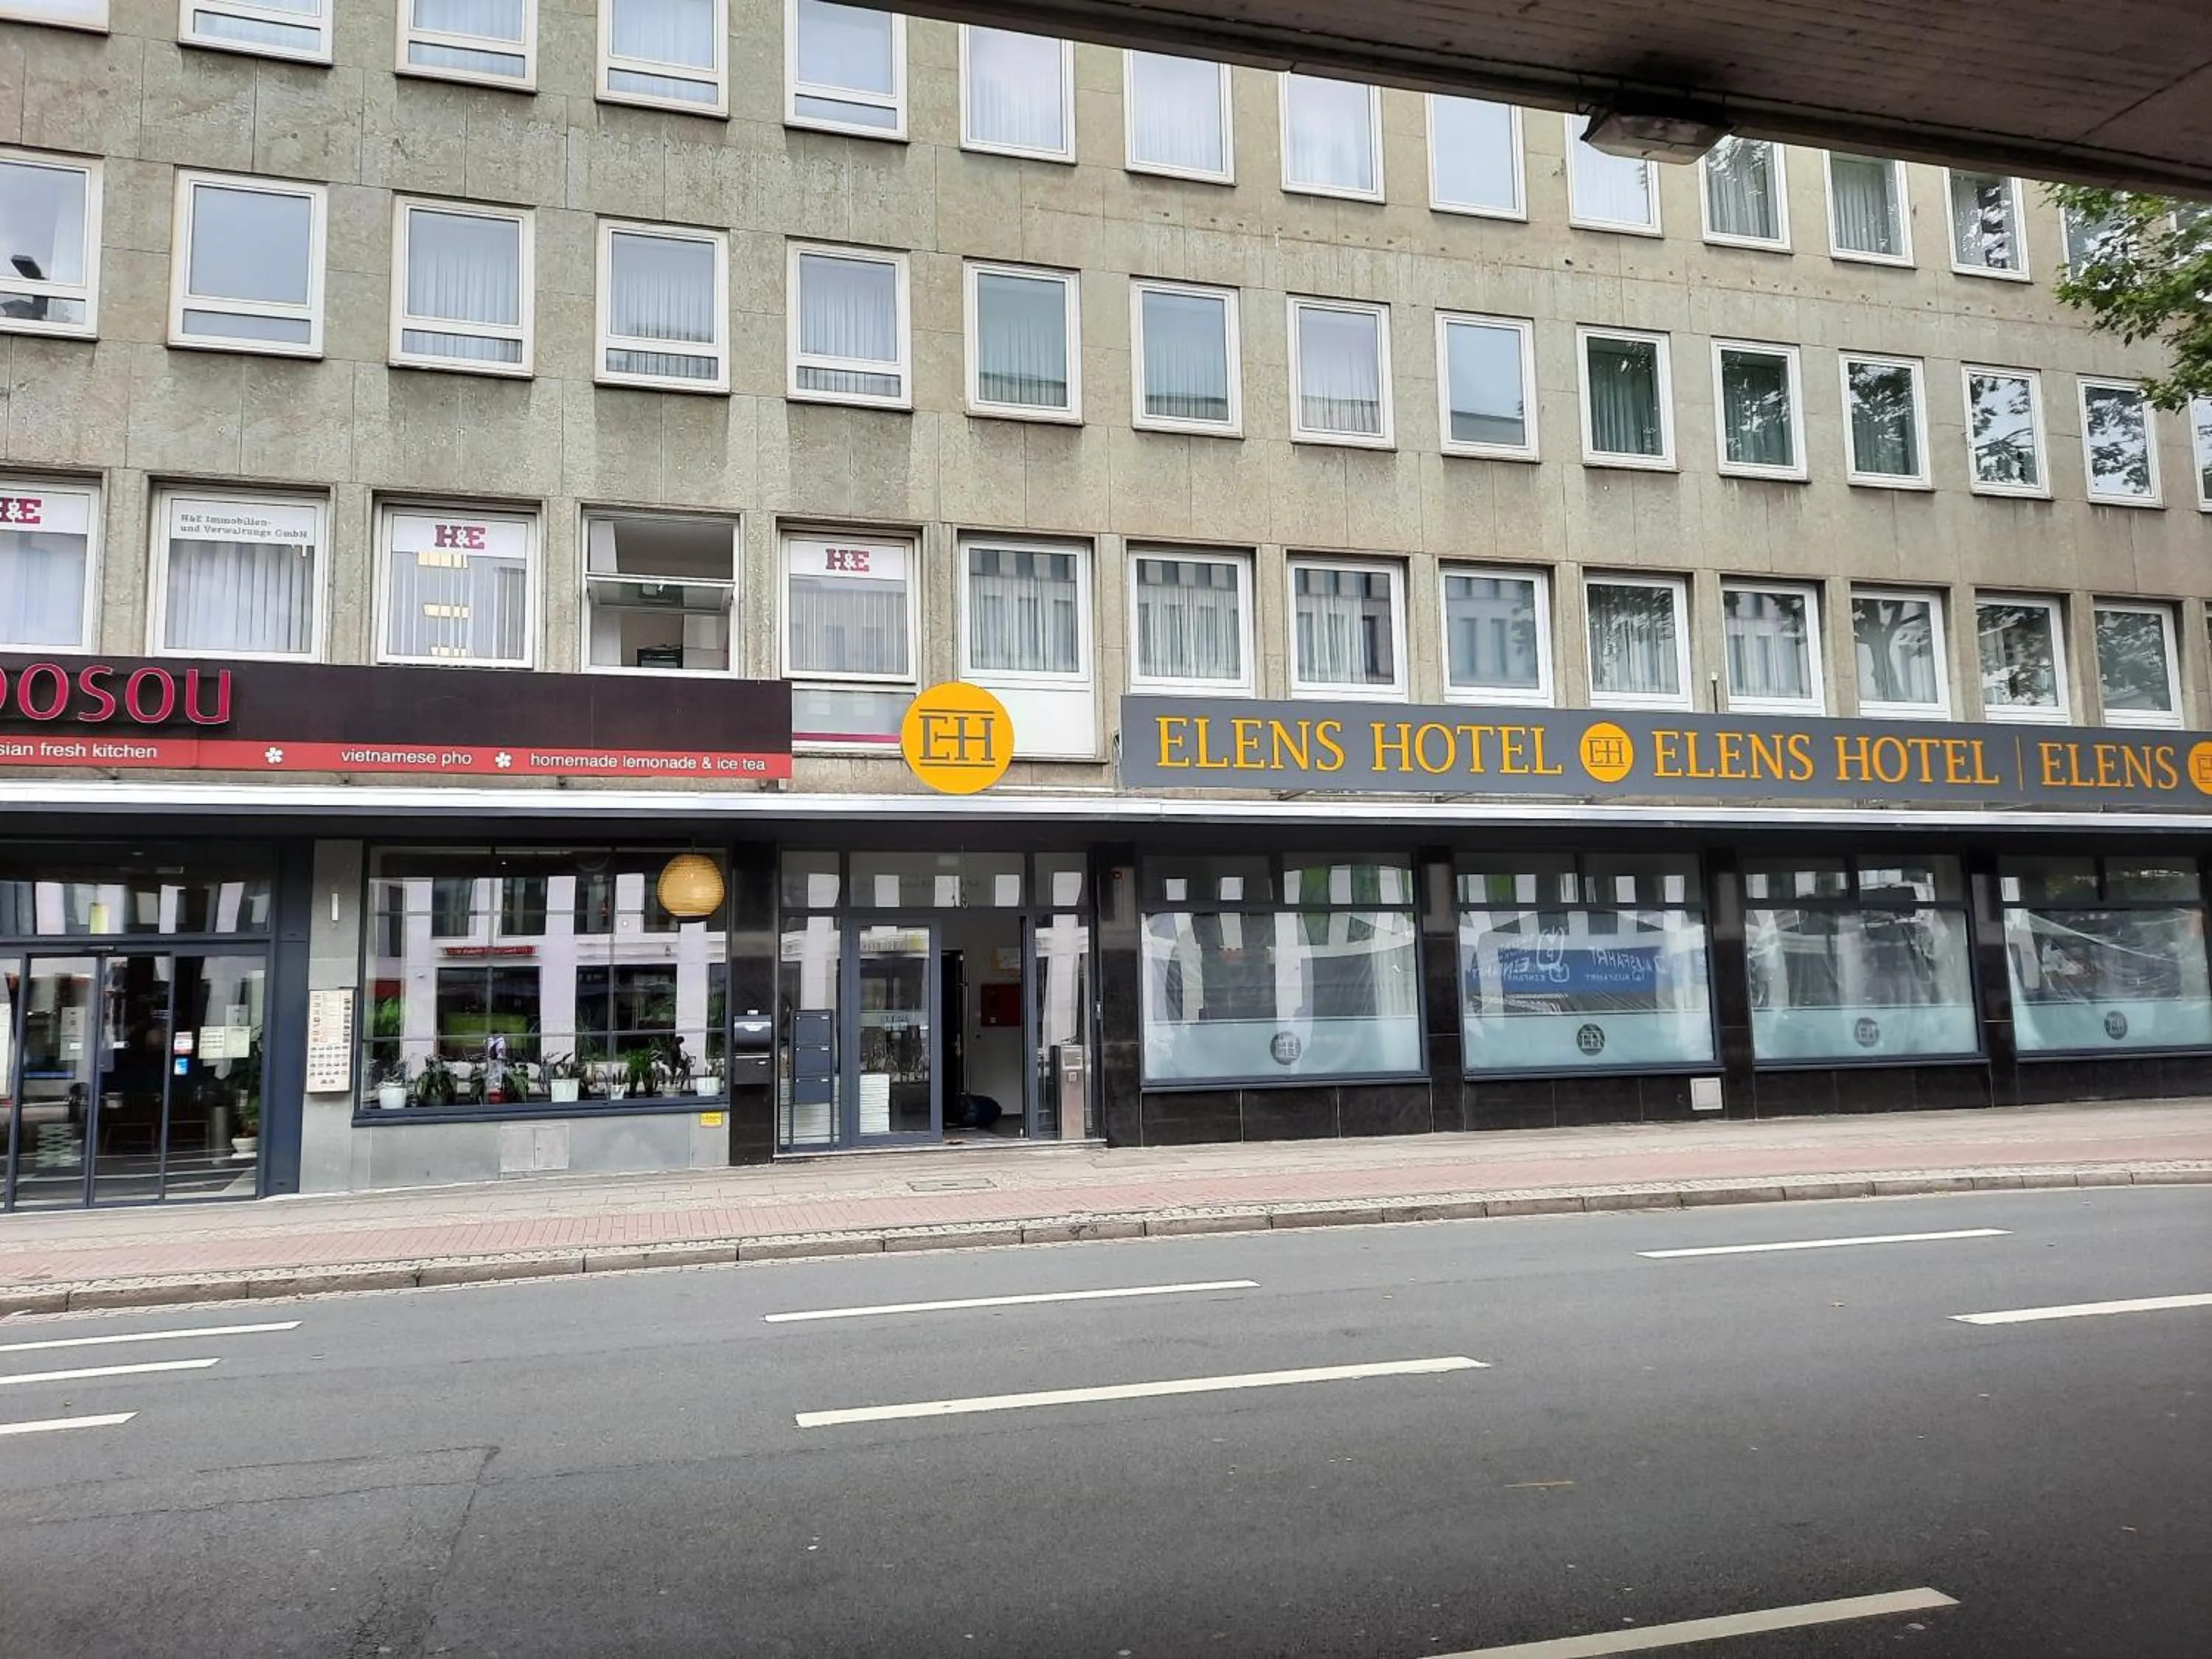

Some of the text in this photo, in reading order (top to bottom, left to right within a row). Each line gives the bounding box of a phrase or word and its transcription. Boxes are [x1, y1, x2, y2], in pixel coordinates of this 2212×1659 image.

[181, 524, 200, 532] und
[275, 529, 307, 538] GmbH
[434, 524, 486, 549] H&E
[825, 548, 869, 572] H&E
[0, 662, 231, 725] OSOU
[41, 742, 86, 758] fresh
[92, 742, 157, 759] kitchen
[341, 748, 472, 767] vietnamese pho
[1155, 717, 1346, 771] ELENS
[1369, 722, 1563, 775] HOTEL
[1651, 730, 1815, 781] ELENS
[1834, 735, 2000, 785] HOTEL
[2037, 742, 2179, 790] ELENS
[530, 753, 766, 771] homemade lemonade & ice tea
